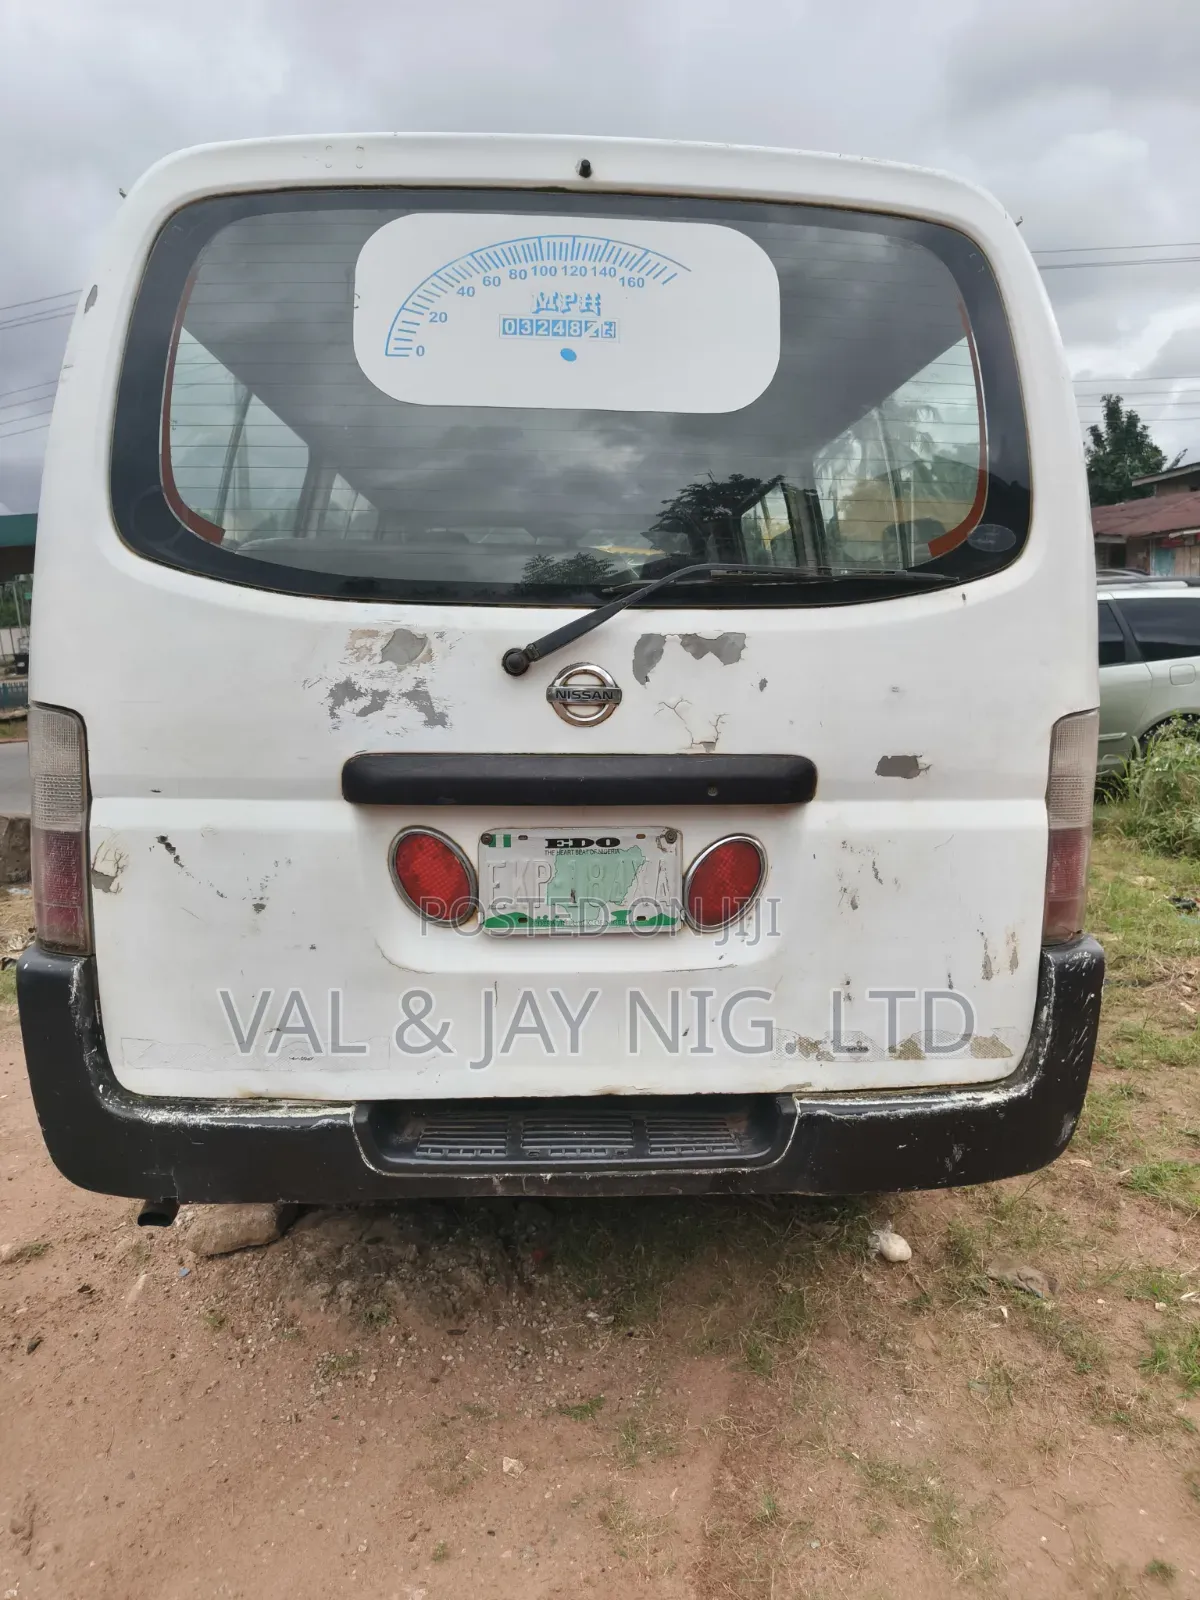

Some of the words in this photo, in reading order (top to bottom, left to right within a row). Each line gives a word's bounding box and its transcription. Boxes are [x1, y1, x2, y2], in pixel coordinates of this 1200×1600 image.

[415, 345, 425, 356] 0
[428, 311, 449, 323] 20
[456, 286, 475, 297] 40
[482, 276, 501, 288] 60
[508, 269, 528, 281] 80
[531, 265, 558, 278] 100
[561, 265, 588, 278] 120
[590, 266, 617, 278] 140
[619, 276, 645, 289] 160
[555, 690, 613, 700] NISSAN
[545, 837, 621, 849] EDO
